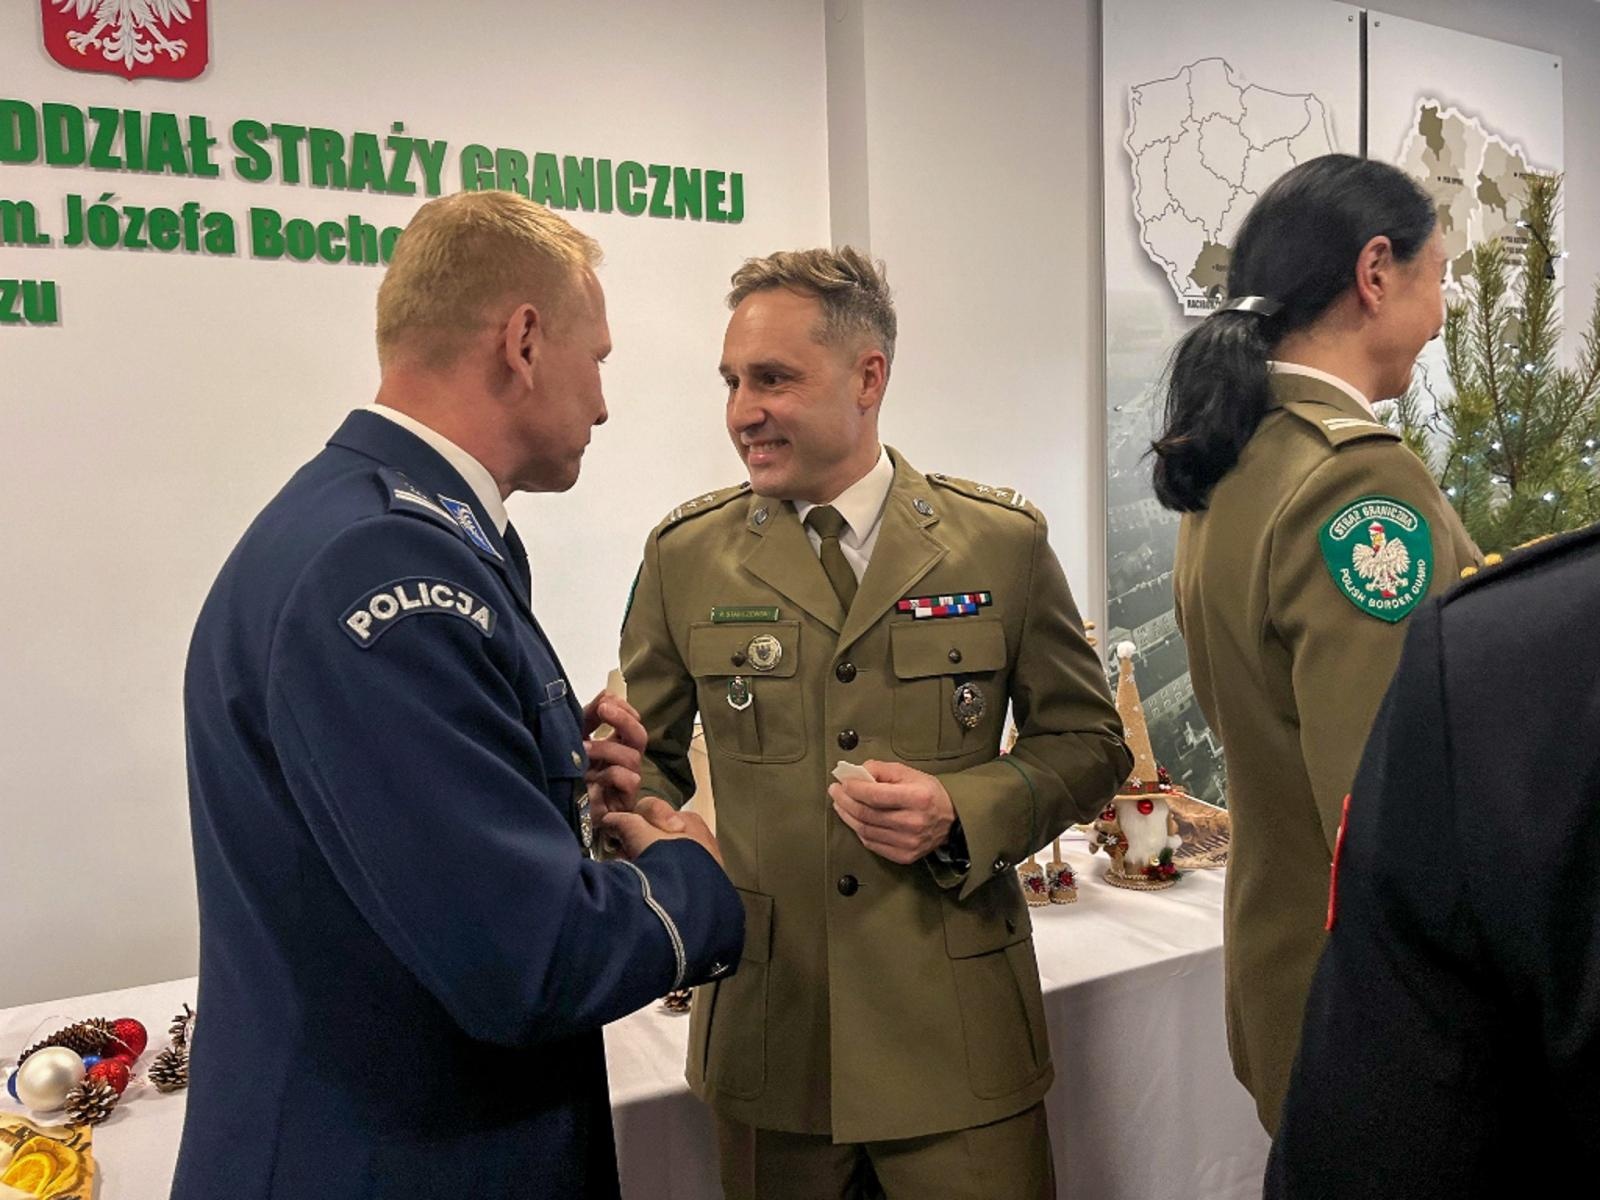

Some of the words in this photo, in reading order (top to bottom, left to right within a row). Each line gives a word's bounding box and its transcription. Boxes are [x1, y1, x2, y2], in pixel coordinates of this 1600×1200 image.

[232, 118, 447, 197] STRAŻY
[461, 144, 745, 222] GRANICZNEJ
[63, 192, 236, 254] Józefa
[1361, 504, 1413, 528] GRANICZNA
[345, 581, 490, 640] POLICJA
[1339, 567, 1367, 604] POLISH
[1367, 592, 1414, 610] BORDER
[1410, 558, 1427, 595] GUARD
